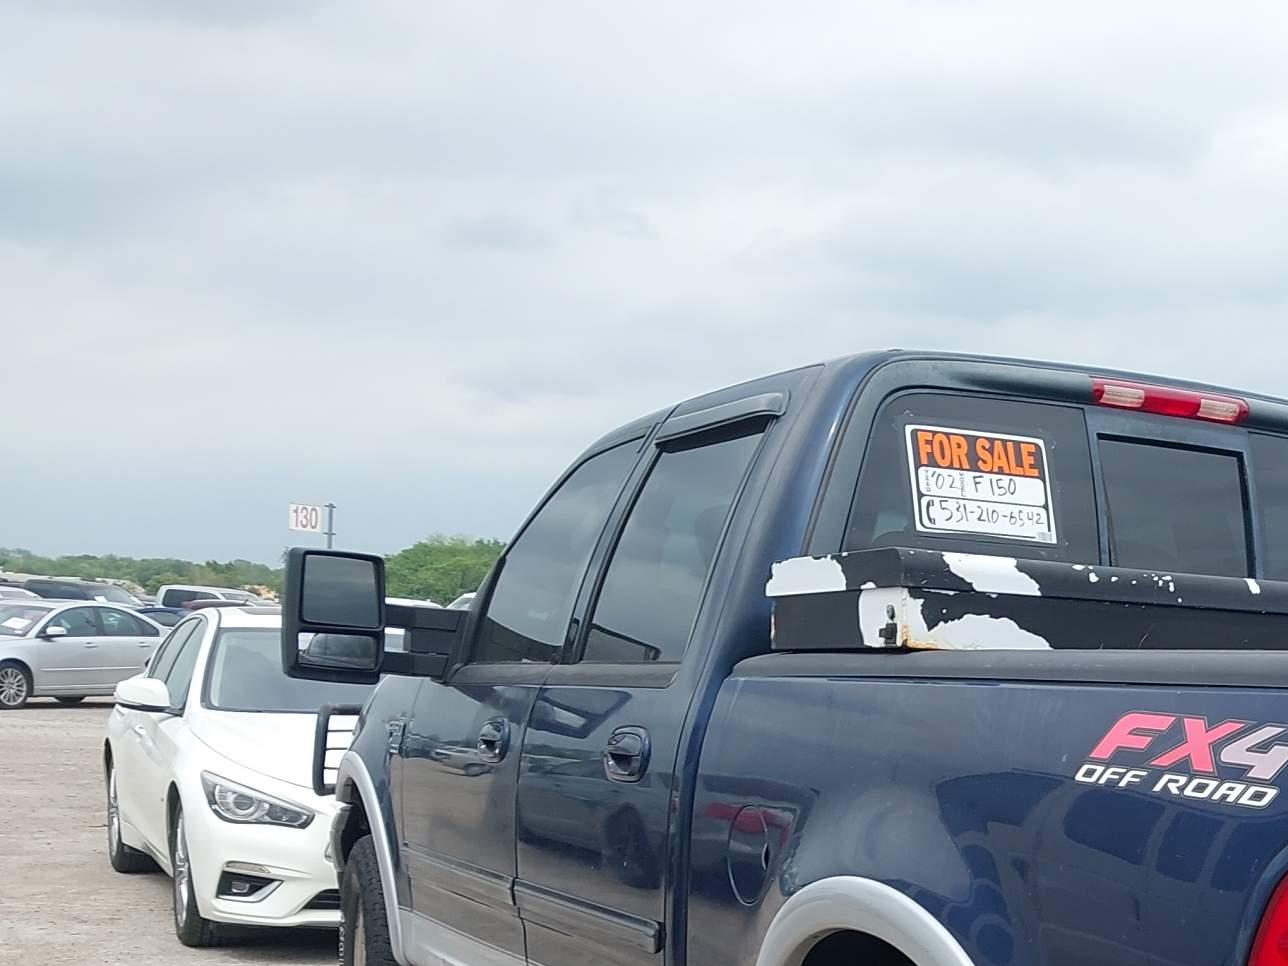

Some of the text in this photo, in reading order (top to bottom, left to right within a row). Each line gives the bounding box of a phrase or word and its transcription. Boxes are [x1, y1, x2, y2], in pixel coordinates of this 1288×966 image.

[916, 431, 1040, 476] FOR SALE
[990, 478, 1017, 497] 150
[292, 506, 319, 530] 130
[1074, 764, 1279, 807] OFF ROAD
